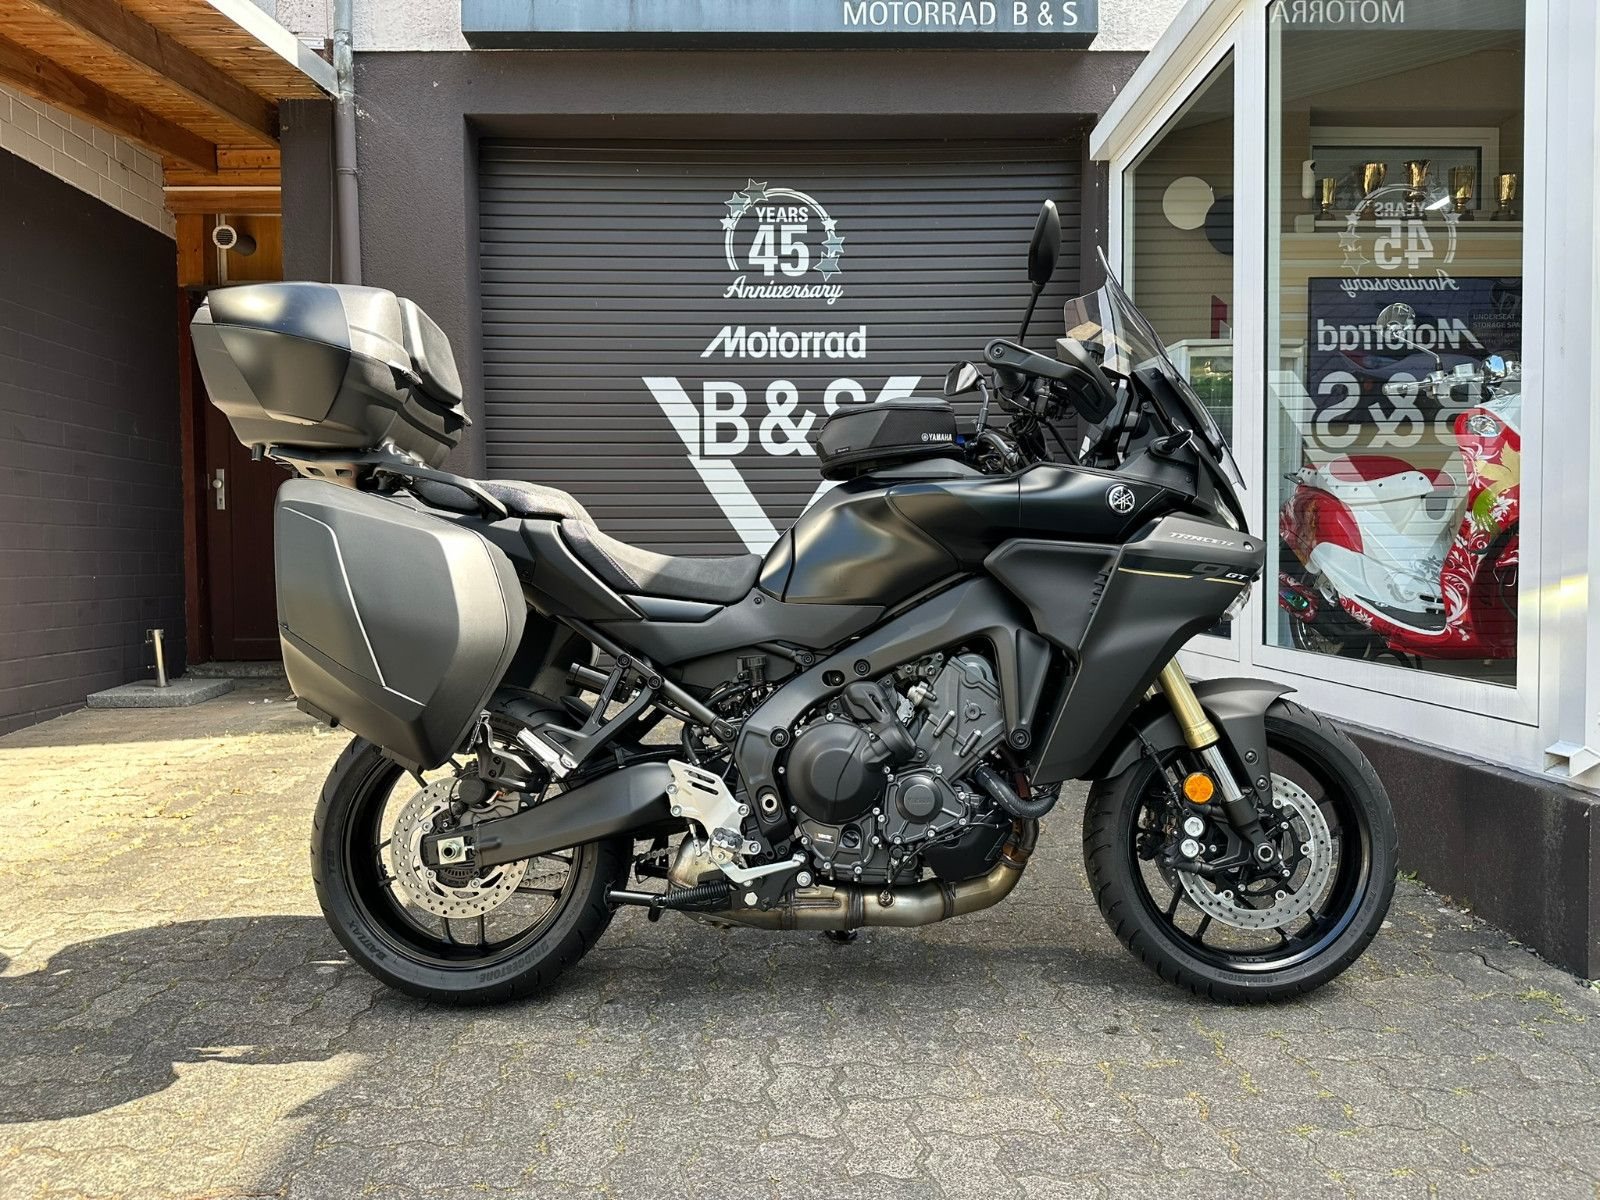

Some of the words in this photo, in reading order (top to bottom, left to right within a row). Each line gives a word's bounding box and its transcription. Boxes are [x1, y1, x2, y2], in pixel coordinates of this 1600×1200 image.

[843, 1, 996, 26] MOTORRAD
[1013, 2, 1028, 26] B
[1037, 2, 1054, 26] &
[1062, 2, 1078, 26] S
[755, 206, 809, 223] YEARS
[748, 224, 810, 277] 45
[723, 275, 844, 305] Anniversary
[700, 325, 867, 359] Motorrad
[928, 433, 953, 441] YAMAHA
[1169, 532, 1235, 546] TRACER
[1225, 572, 1250, 580] GT
